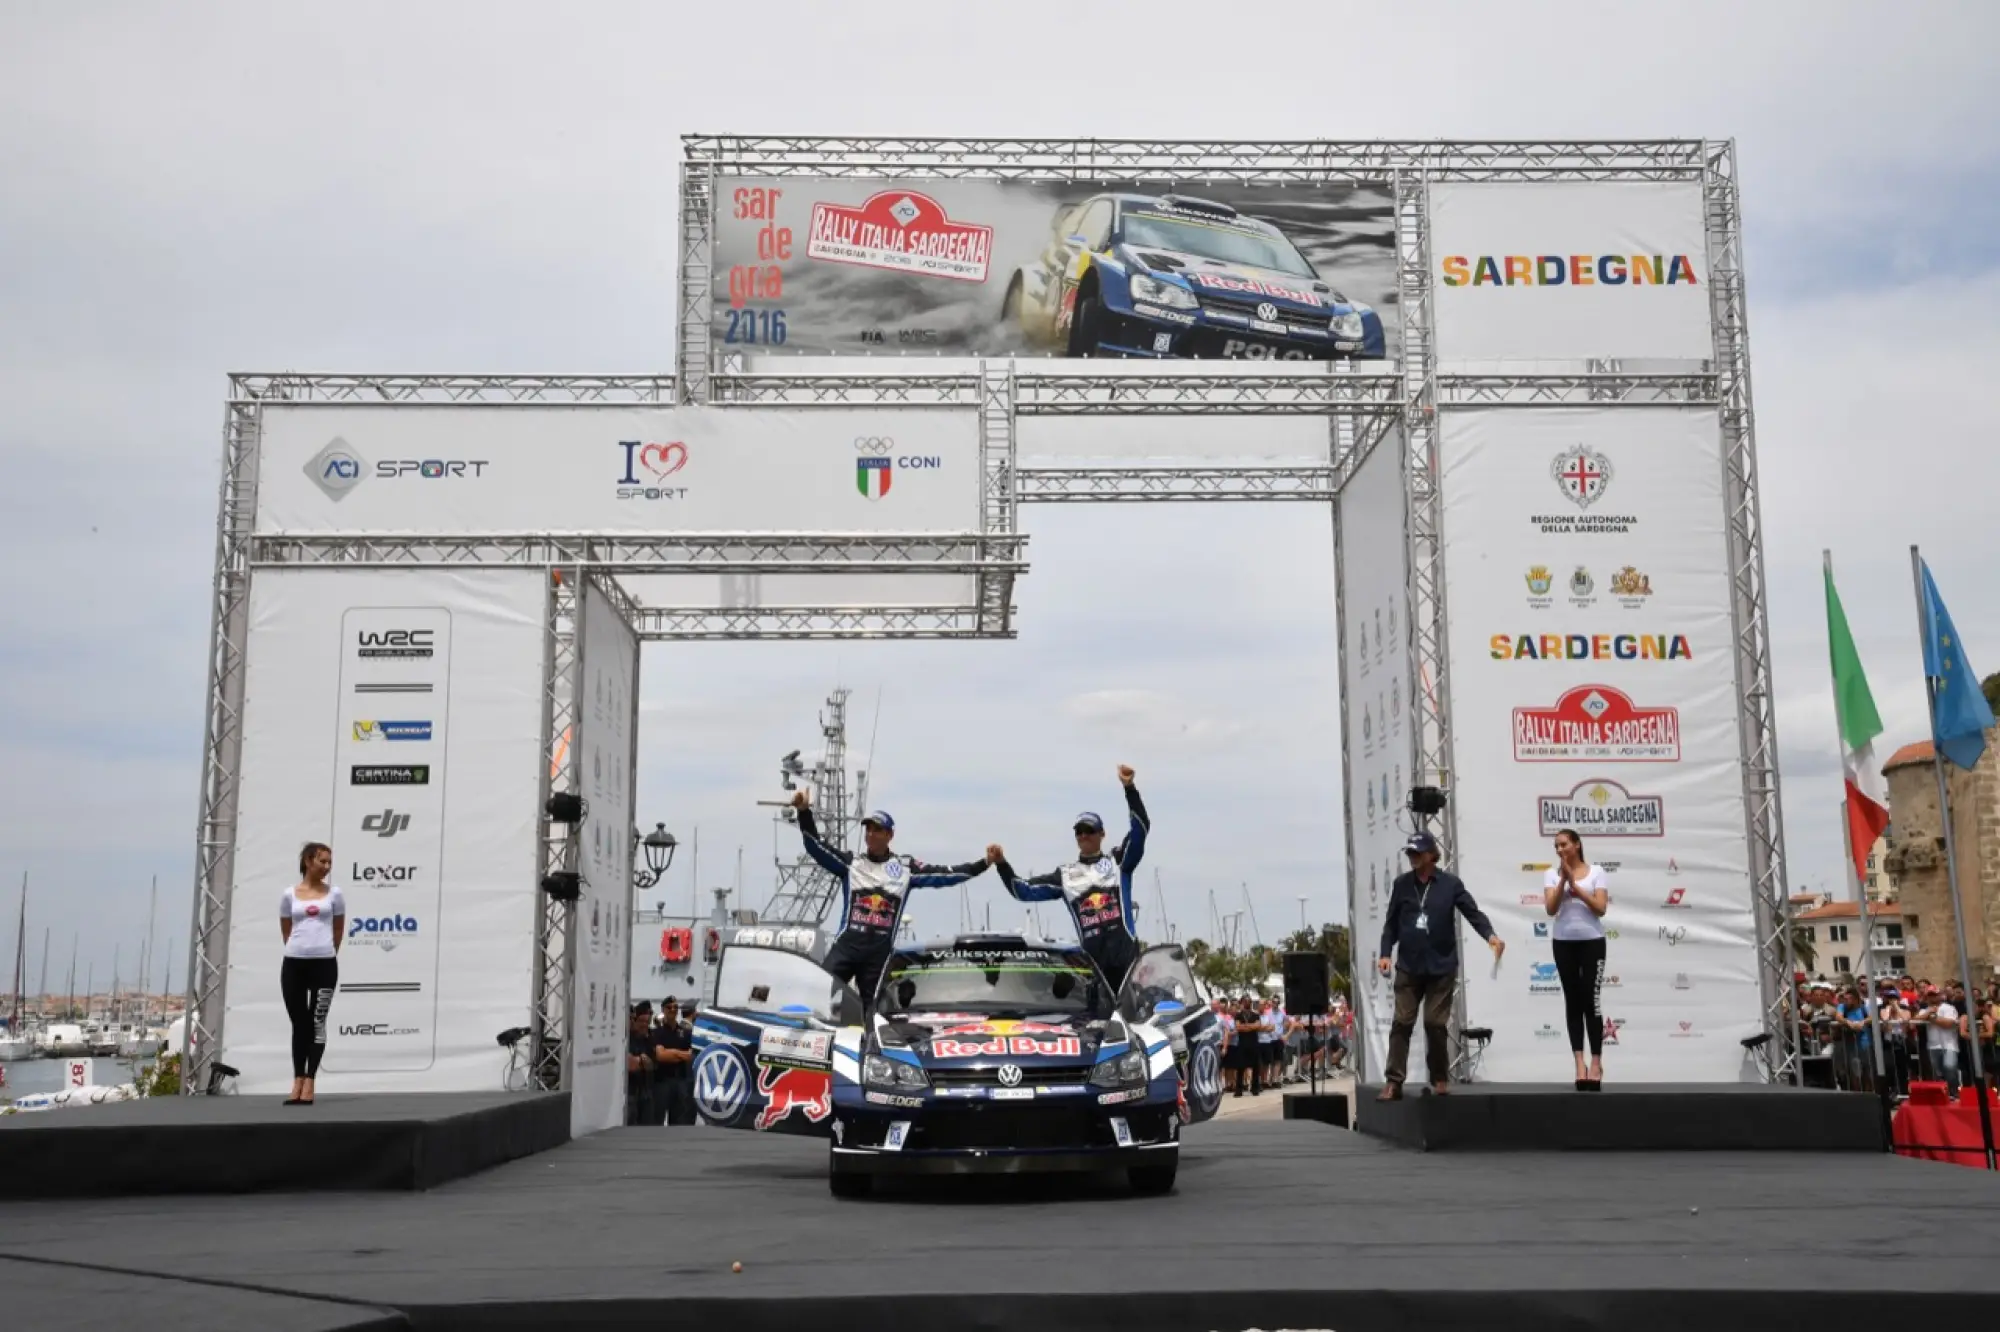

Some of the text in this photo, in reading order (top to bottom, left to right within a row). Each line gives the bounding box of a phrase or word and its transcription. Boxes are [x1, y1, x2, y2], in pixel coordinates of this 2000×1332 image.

[733, 187, 783, 220] sar
[757, 222, 792, 261] de
[815, 208, 988, 264] RALLY ITALIA SARDEGNA
[1442, 256, 1697, 287] SARDEGNA
[1198, 273, 1263, 294] Red
[724, 309, 787, 345] 2016
[323, 460, 490, 479] ACI SPORT
[898, 456, 941, 469] CONI
[616, 488, 689, 500] SPORT
[1531, 515, 1638, 524] REGIONE AUTONOMA
[1541, 525, 1629, 533] DELLA SARDEGNA
[358, 630, 434, 646] WRC
[1490, 634, 1692, 660] SARDEGNA
[1516, 712, 1676, 745] RALLY ITALIA SARDEGNA
[355, 769, 412, 777] CERTINA
[1543, 800, 1658, 824] RALLY DELLA SARDEGNA
[353, 861, 418, 880] Lexar
[348, 913, 418, 938] panta
[931, 950, 1049, 959] Volkswagen
[933, 1036, 1081, 1058] Red Bull
[888, 1094, 926, 1108] EDGE
